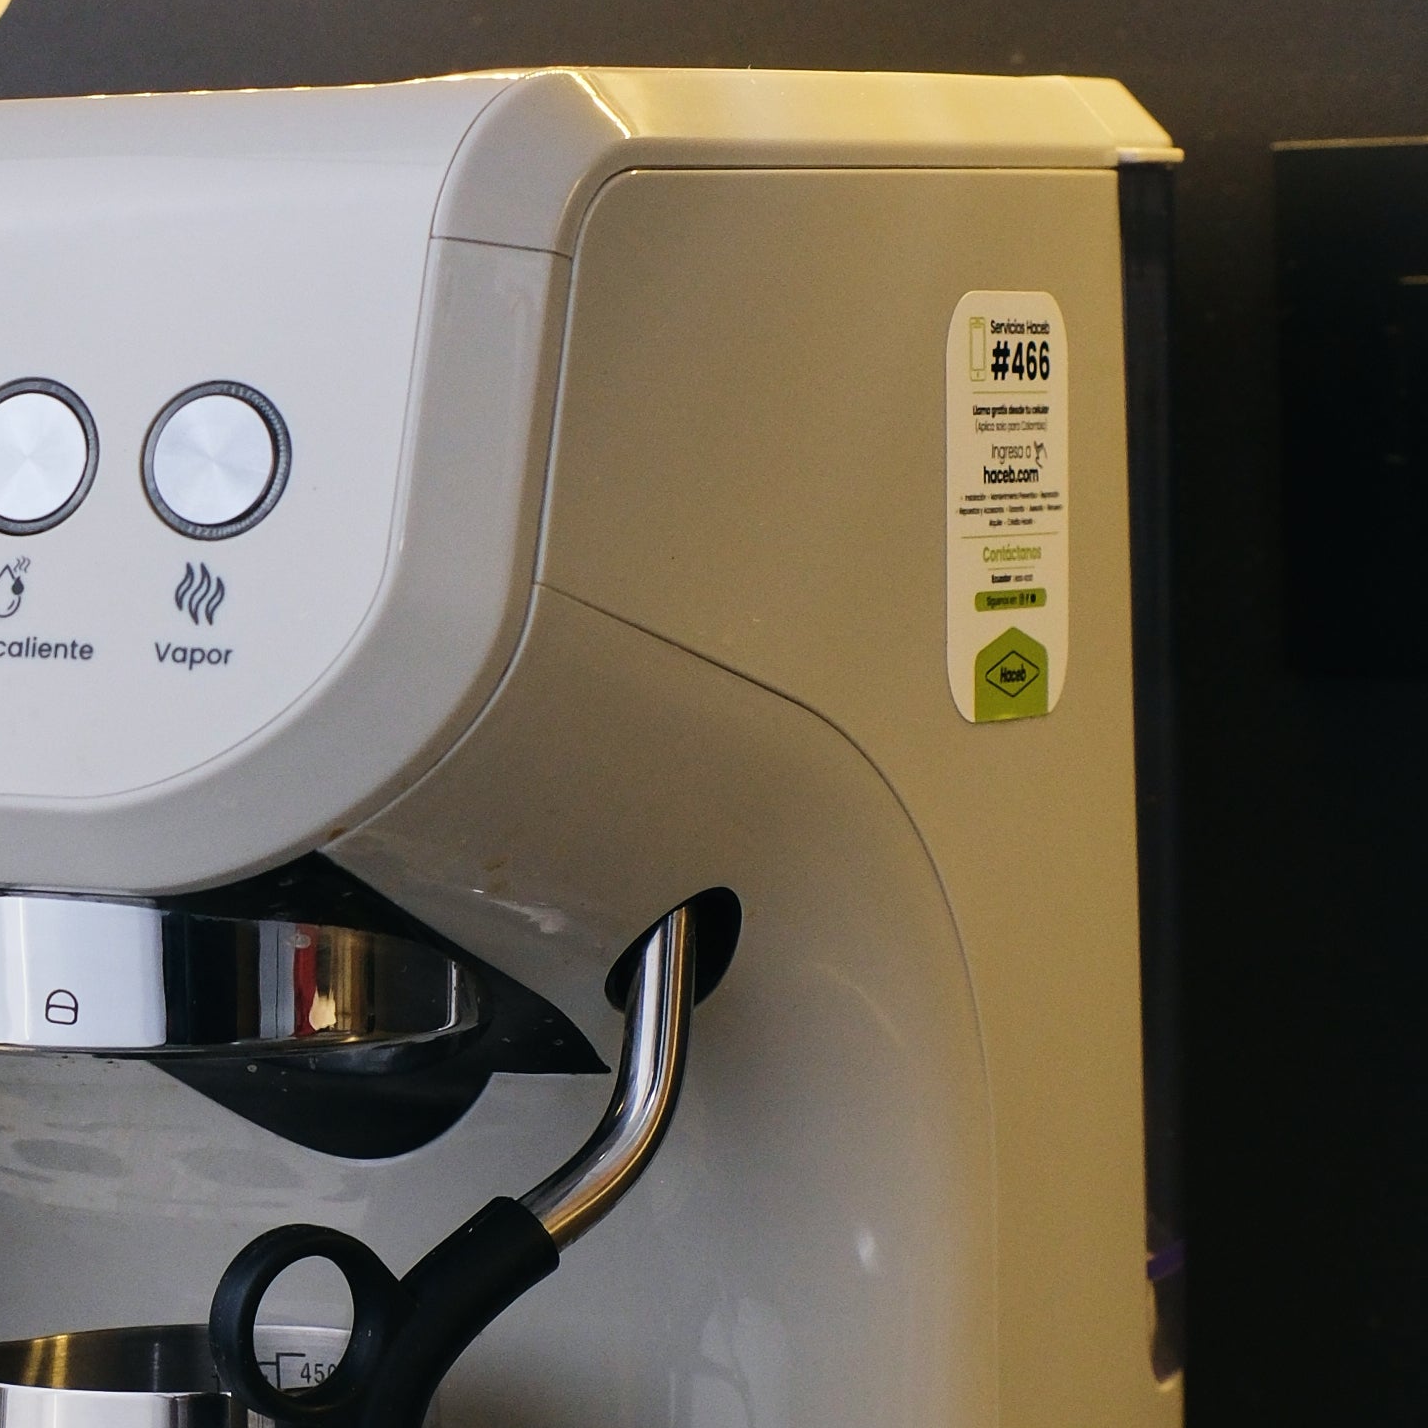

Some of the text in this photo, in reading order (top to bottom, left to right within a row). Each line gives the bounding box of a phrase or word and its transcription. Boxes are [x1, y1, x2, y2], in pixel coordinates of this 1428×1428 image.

[990, 318, 1050, 335] Servicios Haceb
[990, 340, 1050, 381] #466
[983, 465, 1039, 484] haceb.com
[983, 544, 1042, 563] Contáctanos
[154, 642, 233, 671] Vapor
[999, 664, 1027, 684] Haceb
